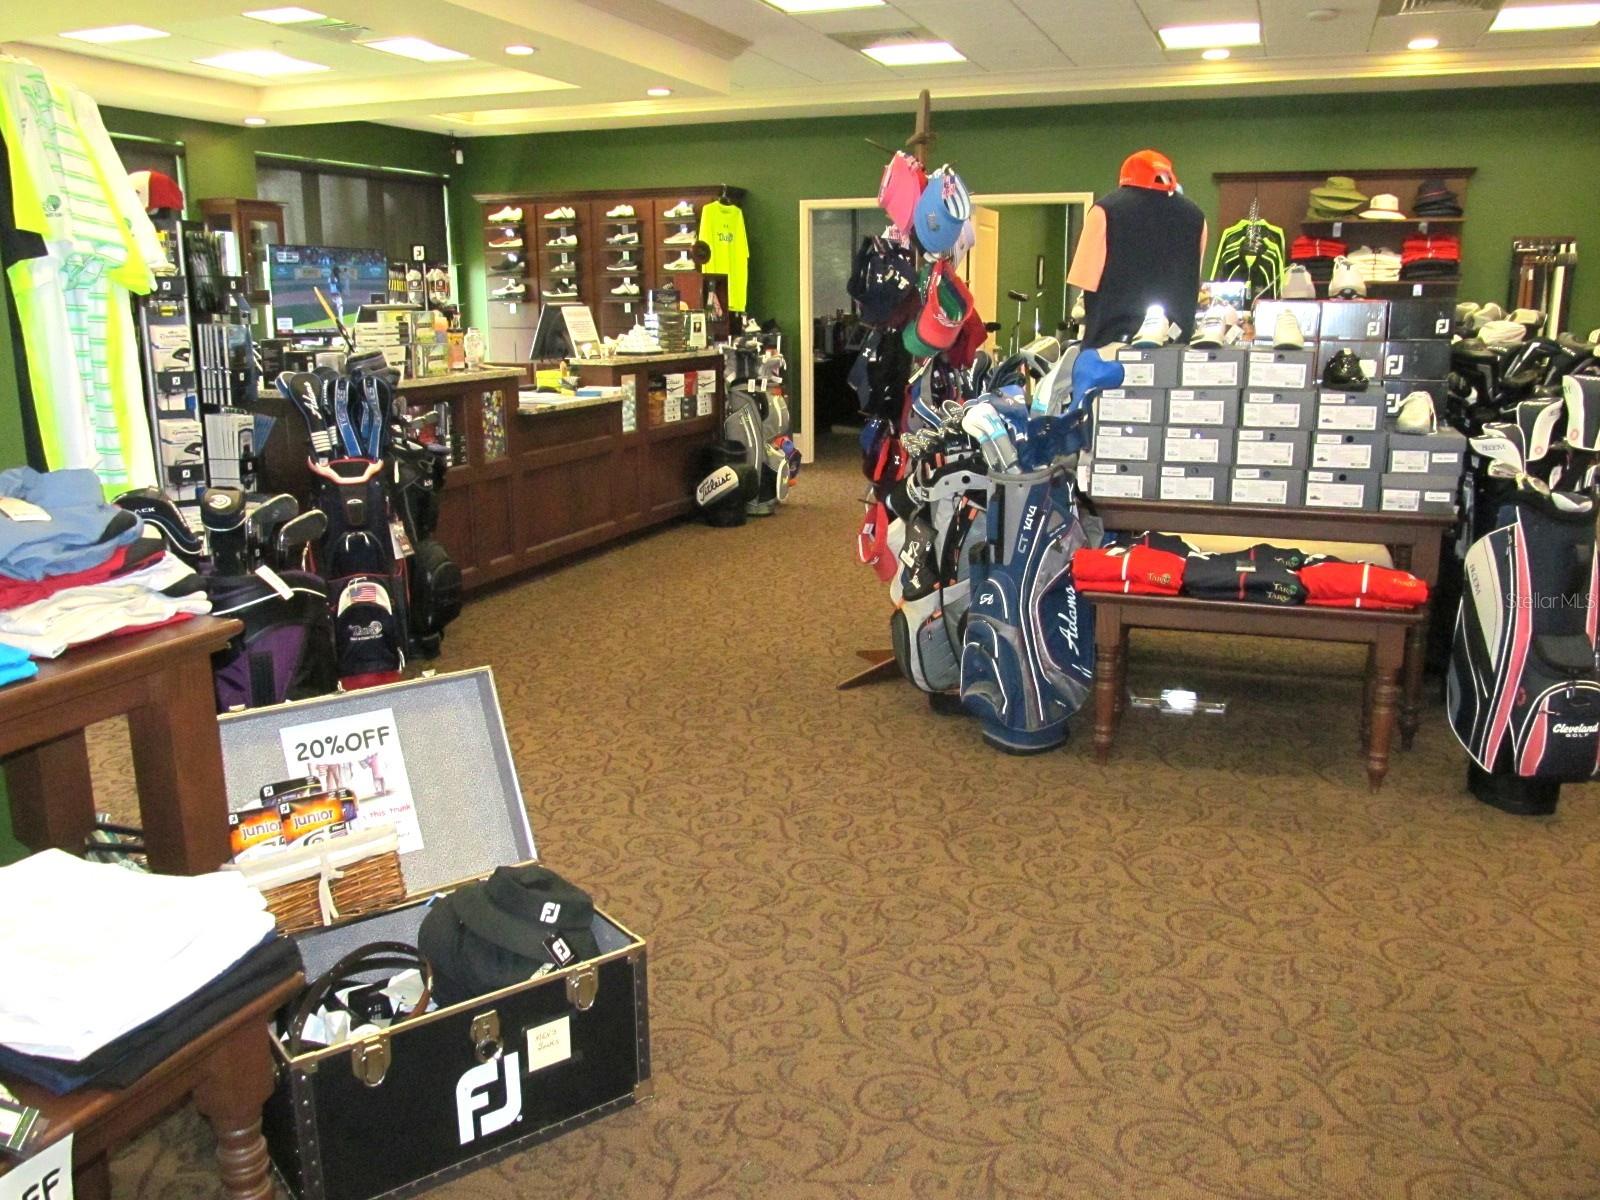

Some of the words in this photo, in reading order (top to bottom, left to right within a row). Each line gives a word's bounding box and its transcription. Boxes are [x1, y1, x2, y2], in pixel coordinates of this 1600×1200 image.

[1367, 322, 1380, 336] FJ
[1436, 319, 1450, 334] FJ
[1385, 355, 1404, 375] FJ
[699, 472, 732, 501] Titleist
[1058, 584, 1080, 656] Adams
[1552, 722, 1599, 734] Cleveland
[294, 809, 333, 829] junior
[540, 901, 561, 924] FJ
[552, 937, 571, 962] FJ
[456, 1051, 522, 1145] FJ
